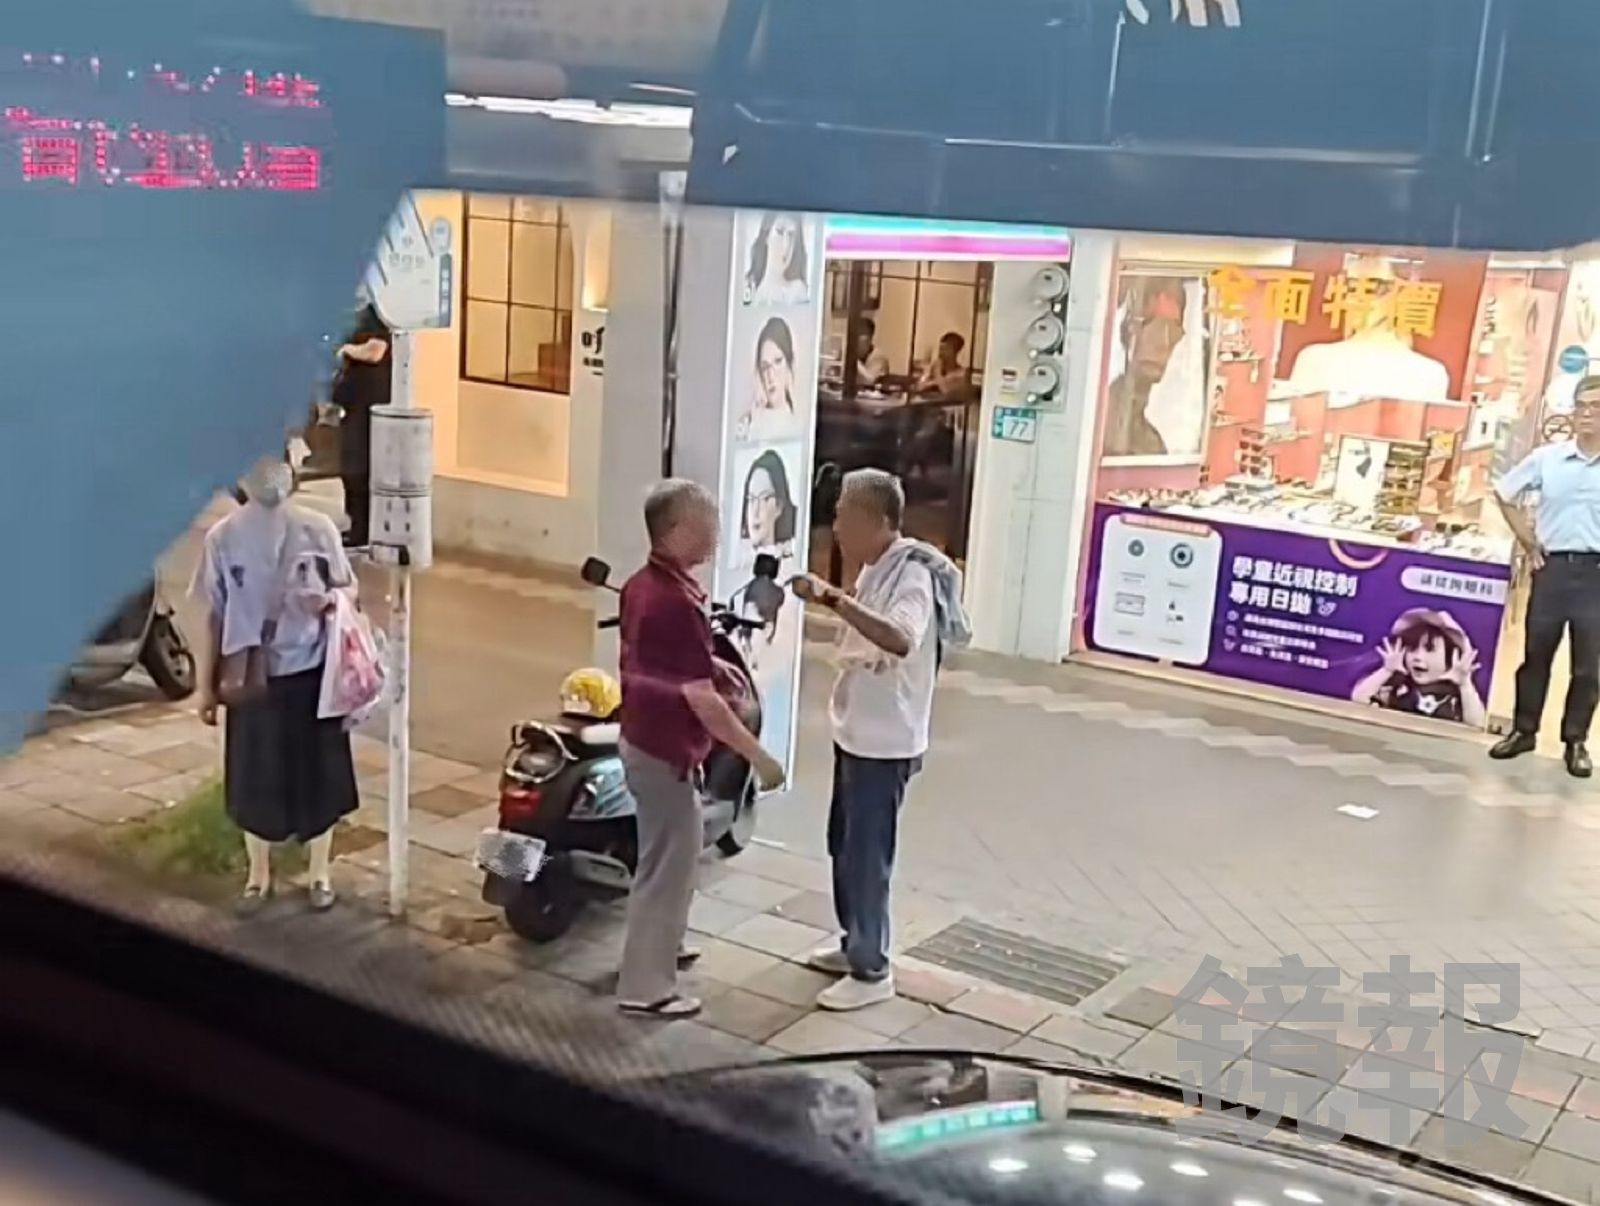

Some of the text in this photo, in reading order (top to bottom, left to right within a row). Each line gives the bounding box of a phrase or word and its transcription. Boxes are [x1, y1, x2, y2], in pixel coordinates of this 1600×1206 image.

[1009, 420, 1029, 437] 77
[1232, 555, 1358, 597] 學童近視控制
